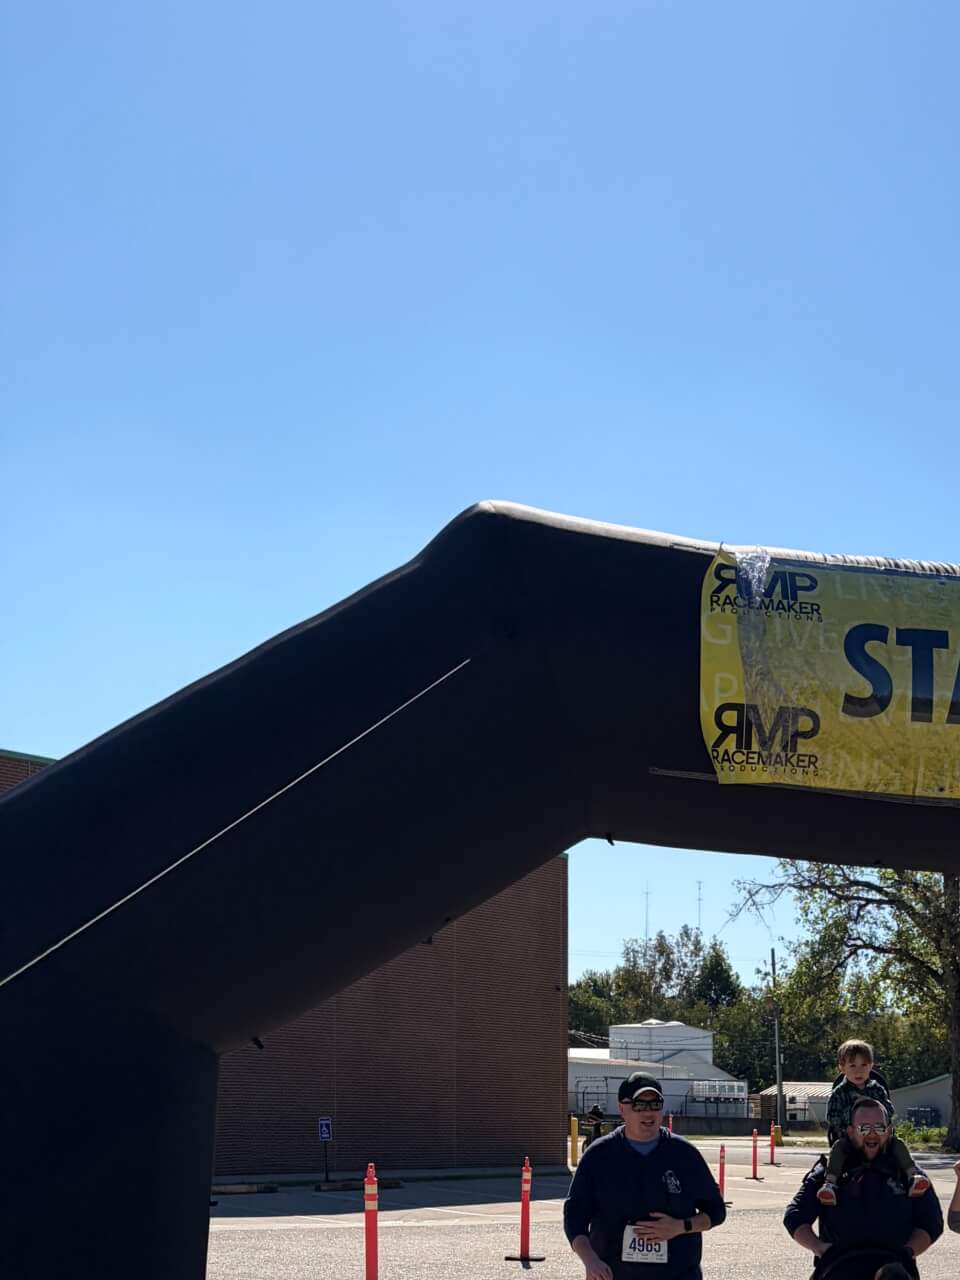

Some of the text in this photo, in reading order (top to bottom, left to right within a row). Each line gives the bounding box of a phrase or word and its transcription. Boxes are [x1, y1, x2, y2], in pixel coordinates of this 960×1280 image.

[710, 594, 822, 616] RACEMAKER
[710, 607, 823, 622] PROCTIONS
[711, 749, 819, 769] RACEMAKER
[717, 764, 819, 777] RODUCTIONS
